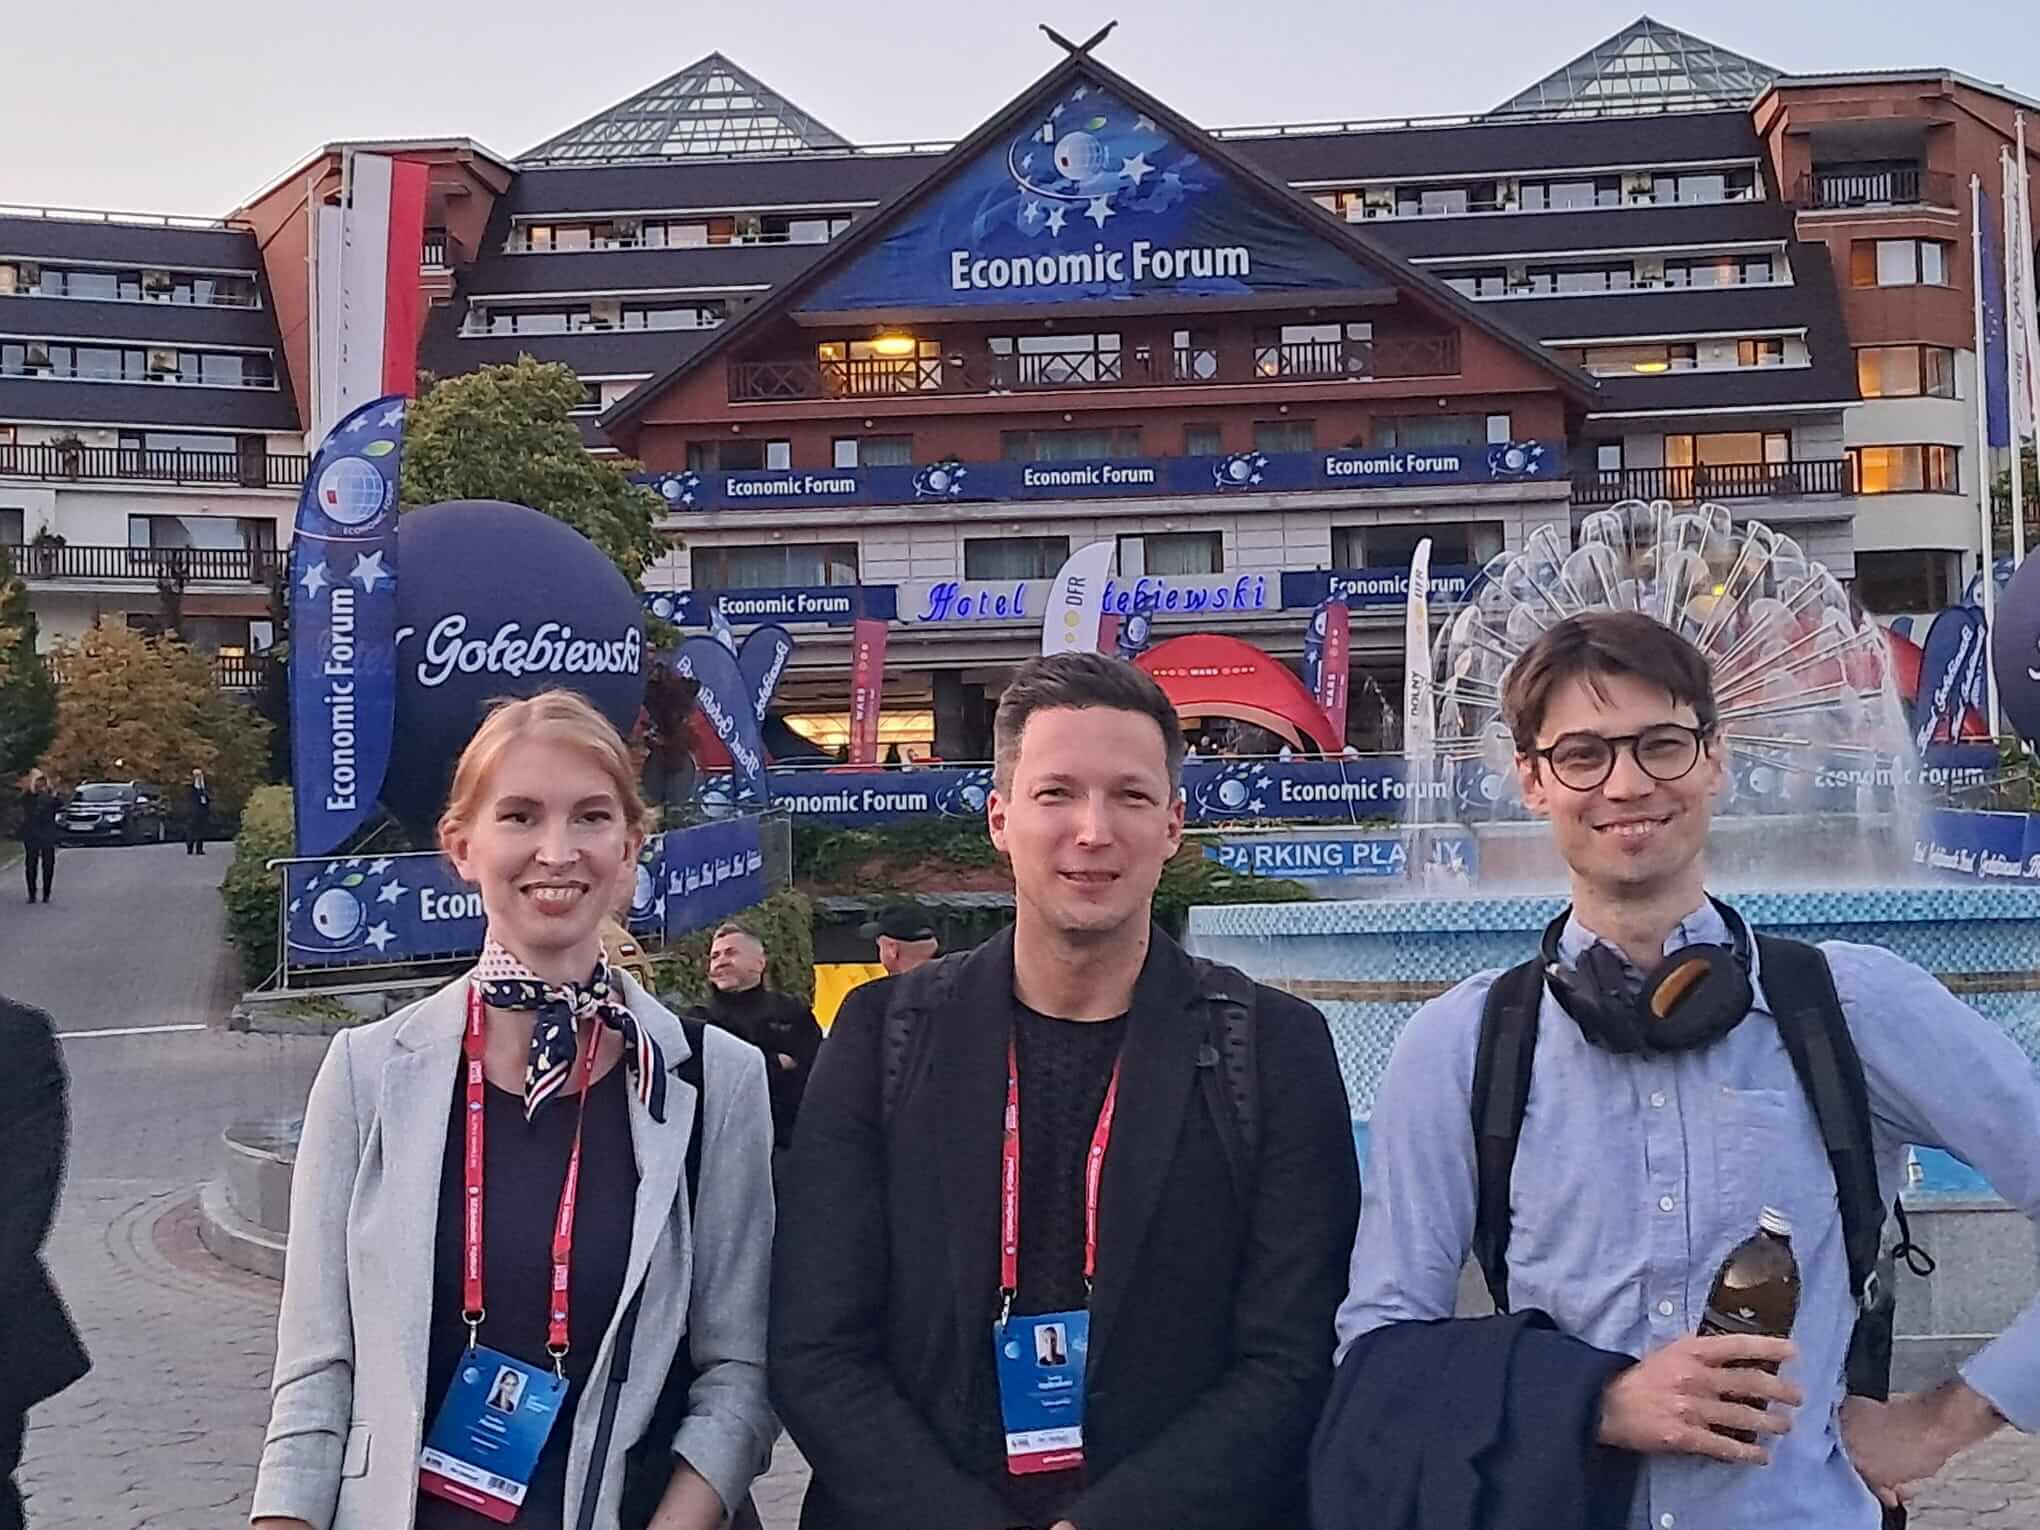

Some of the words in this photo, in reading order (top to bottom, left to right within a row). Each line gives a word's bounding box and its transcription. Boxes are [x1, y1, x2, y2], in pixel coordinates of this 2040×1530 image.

[951, 243, 1124, 290] Economic
[1132, 241, 1250, 280] Forum
[1023, 466, 1099, 487] Economic
[1102, 464, 1155, 484] Forum
[1325, 456, 1404, 476] Economic
[1407, 454, 1460, 473] Forum
[726, 476, 803, 496] Economic
[805, 475, 856, 495] Forum
[718, 594, 794, 614] Economic
[797, 594, 850, 612] Forum
[917, 582, 1025, 621] Hotel
[1065, 576, 1086, 607] DFR
[323, 587, 355, 676] Forum
[417, 614, 641, 687] Gołębiewski
[323, 680, 358, 812] Economic
[862, 789, 928, 811] Forum
[1281, 777, 1379, 802] Economic
[1382, 777, 1448, 798] Forum
[1219, 843, 1344, 869] PARKING
[420, 886, 486, 921] Econ
